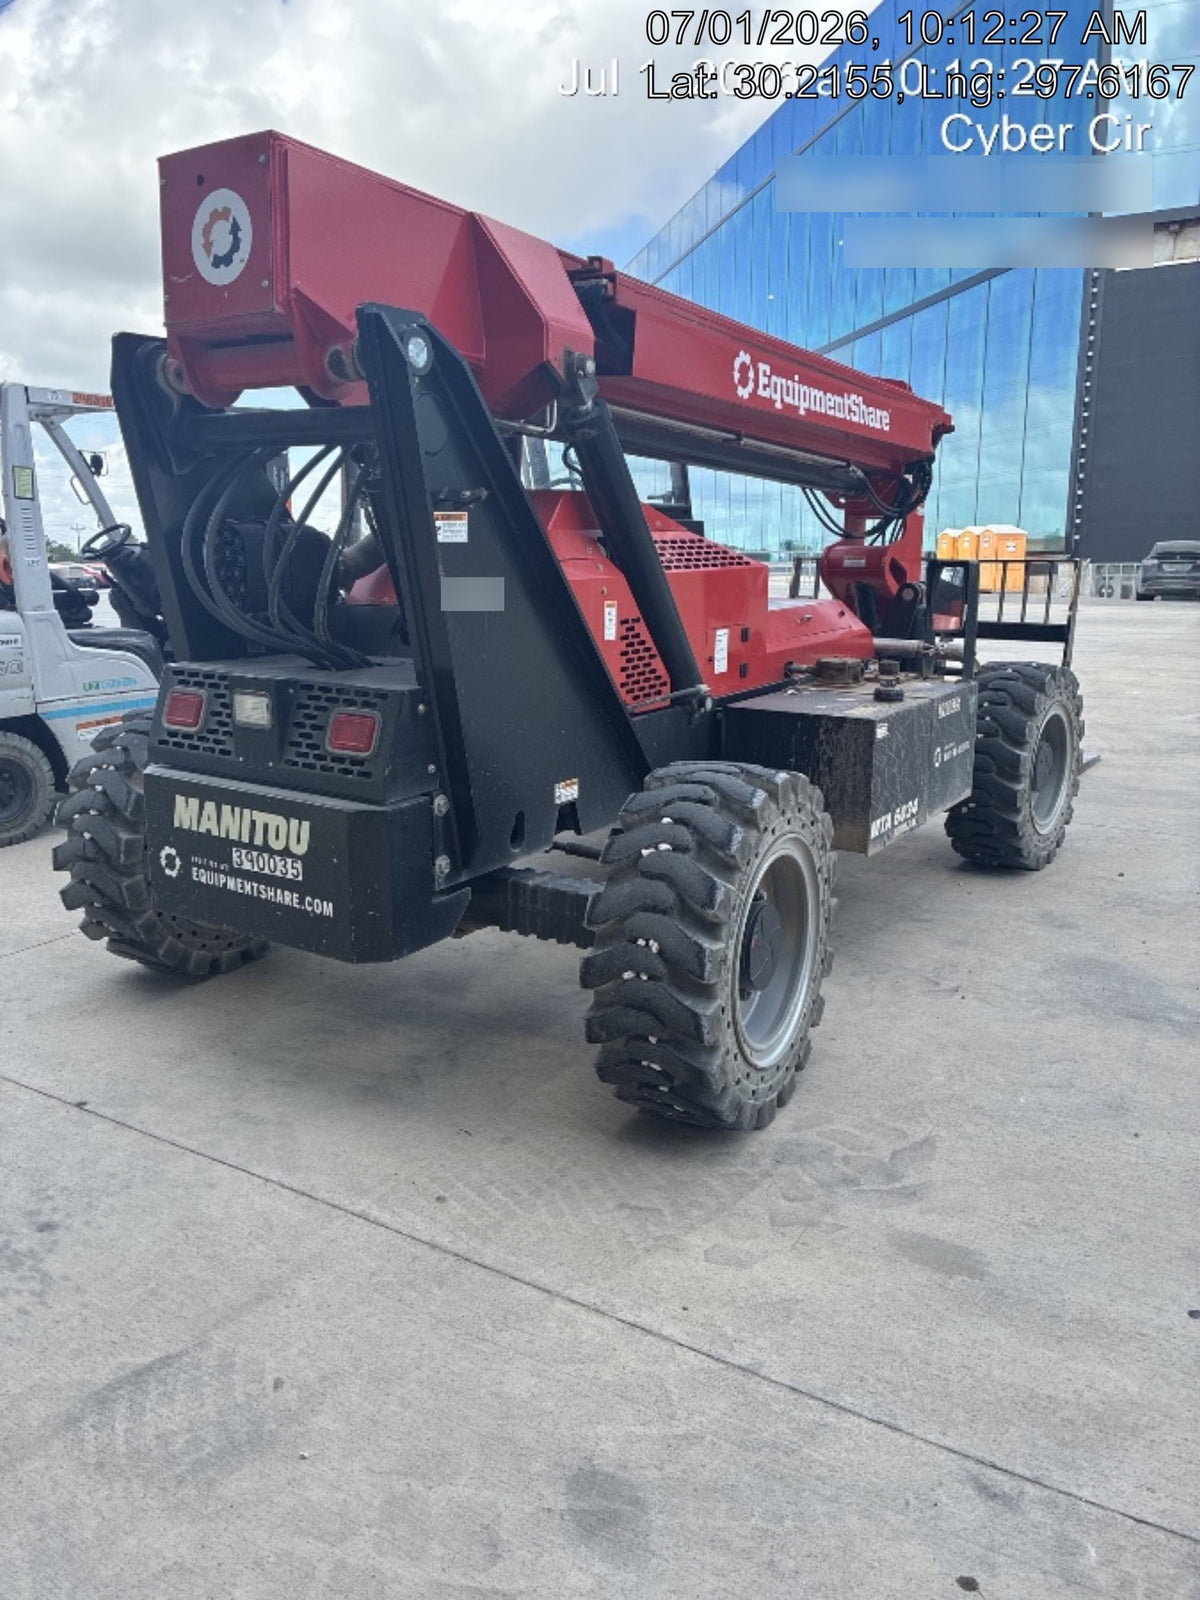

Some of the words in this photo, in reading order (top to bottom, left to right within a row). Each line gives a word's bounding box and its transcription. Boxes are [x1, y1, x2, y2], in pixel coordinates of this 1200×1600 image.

[757, 362, 890, 431] EquipmentShare
[173, 794, 311, 856] MANITOU
[191, 866, 334, 918] EQUIPMENTSHARE.COM
[234, 848, 302, 880] 390035
